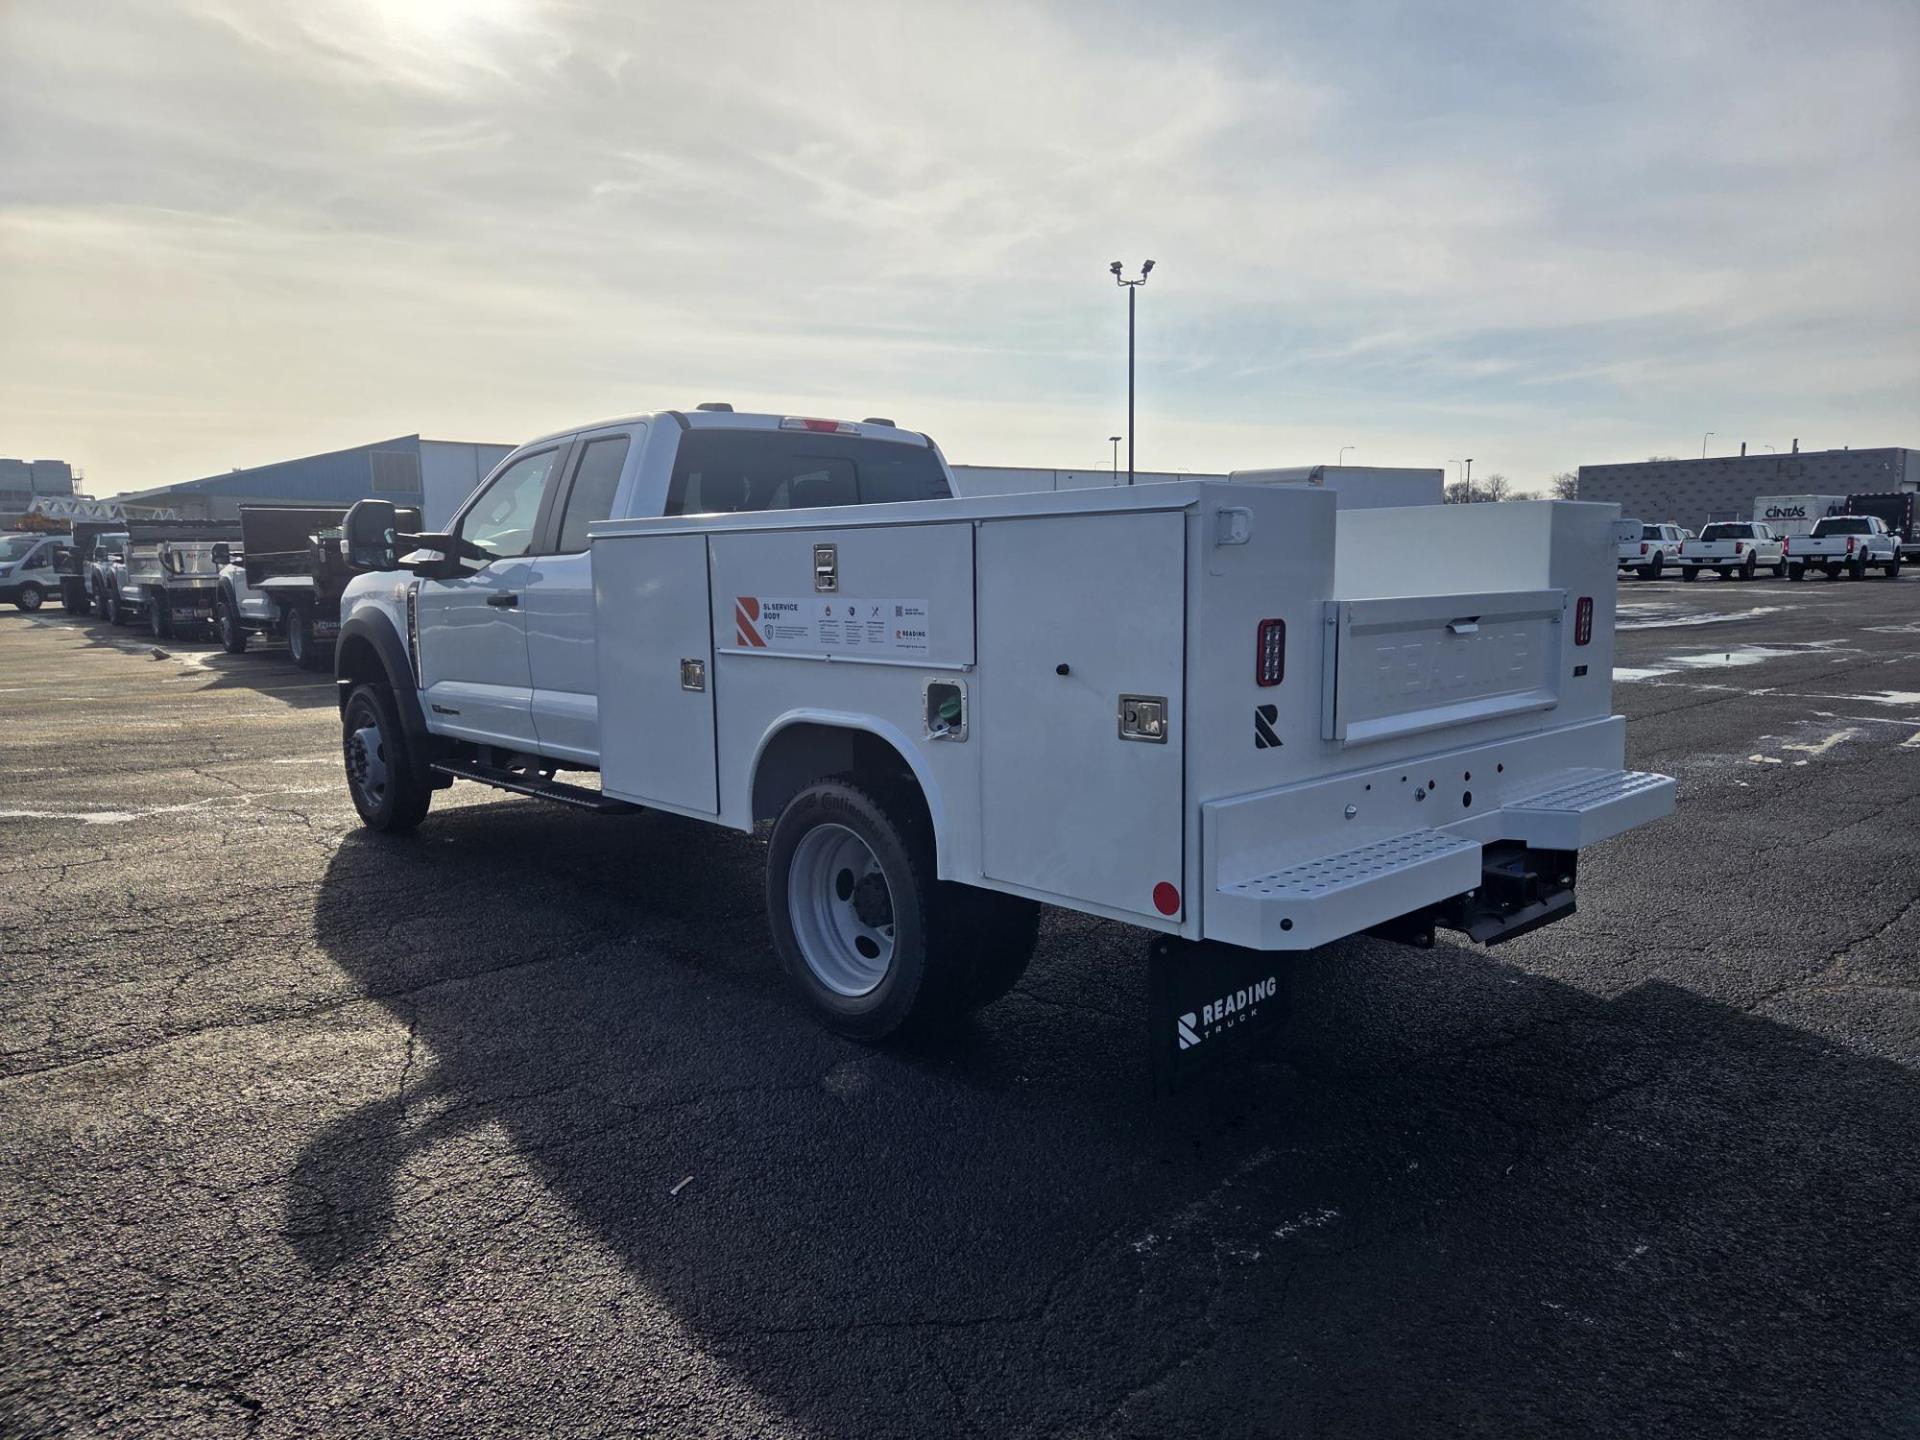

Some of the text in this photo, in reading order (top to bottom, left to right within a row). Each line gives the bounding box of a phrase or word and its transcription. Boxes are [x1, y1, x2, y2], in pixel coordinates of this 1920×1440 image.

[763, 611, 781, 621] BODY
[771, 603, 799, 612] SERVICE
[1202, 977, 1276, 1025] READING
[1204, 1008, 1258, 1040] TRUCK
